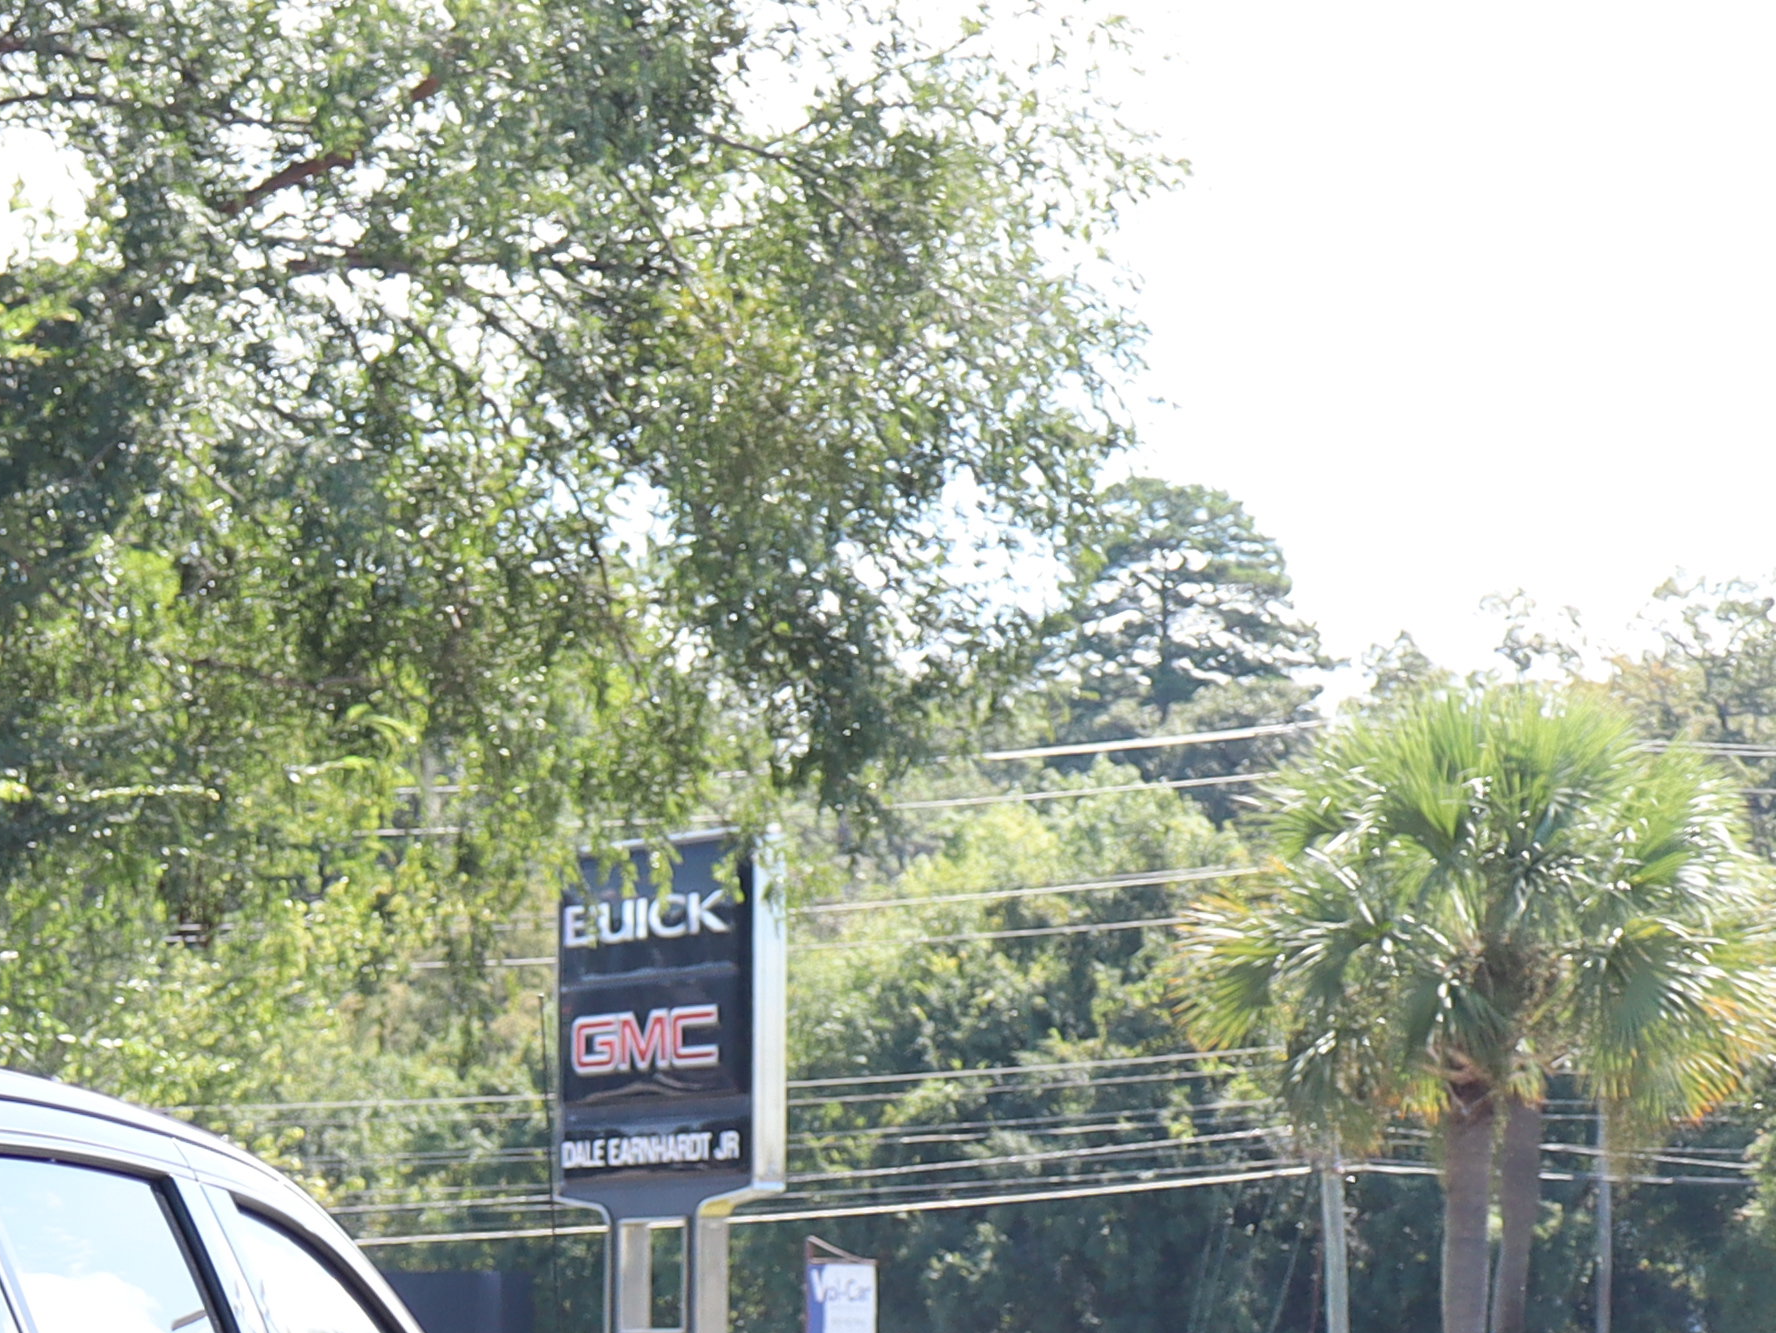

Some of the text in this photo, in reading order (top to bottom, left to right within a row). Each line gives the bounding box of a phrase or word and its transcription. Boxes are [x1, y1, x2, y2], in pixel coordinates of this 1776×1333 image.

[563, 889, 730, 947] BUICK
[572, 1004, 719, 1076] GMC
[561, 1130, 740, 1169] DALE EARNHARDT JR
